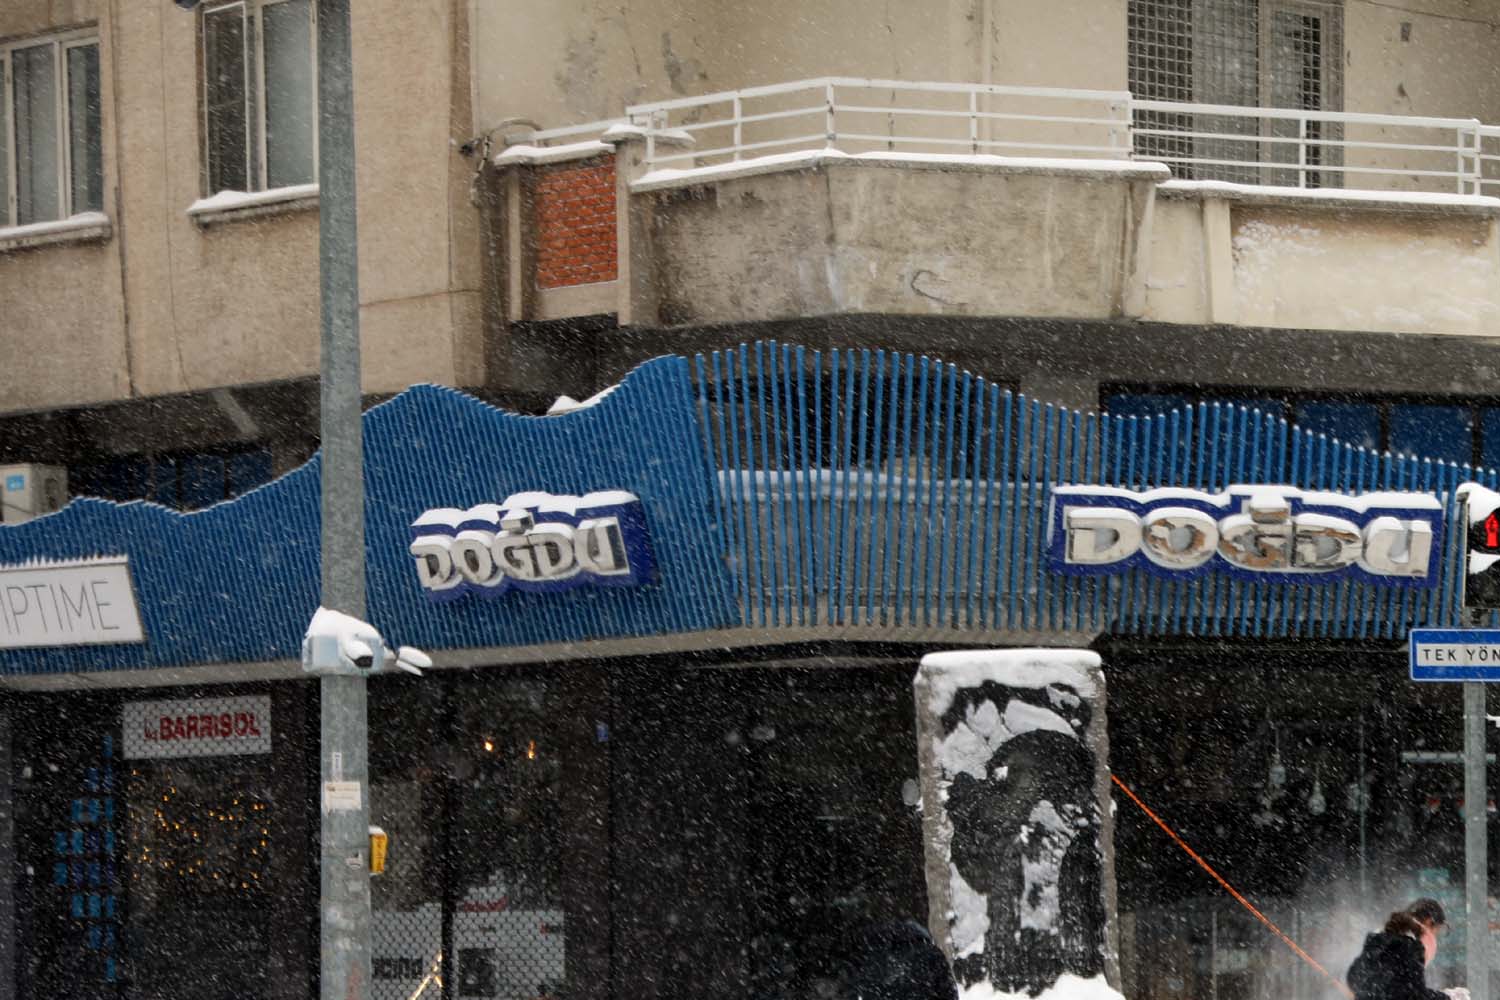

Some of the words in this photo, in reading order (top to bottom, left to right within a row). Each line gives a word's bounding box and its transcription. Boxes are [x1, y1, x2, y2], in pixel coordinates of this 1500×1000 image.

[410, 508, 631, 591] DOĞDU
[1064, 498, 1432, 578] DOĞDU
[1423, 648, 1457, 661] TEK
